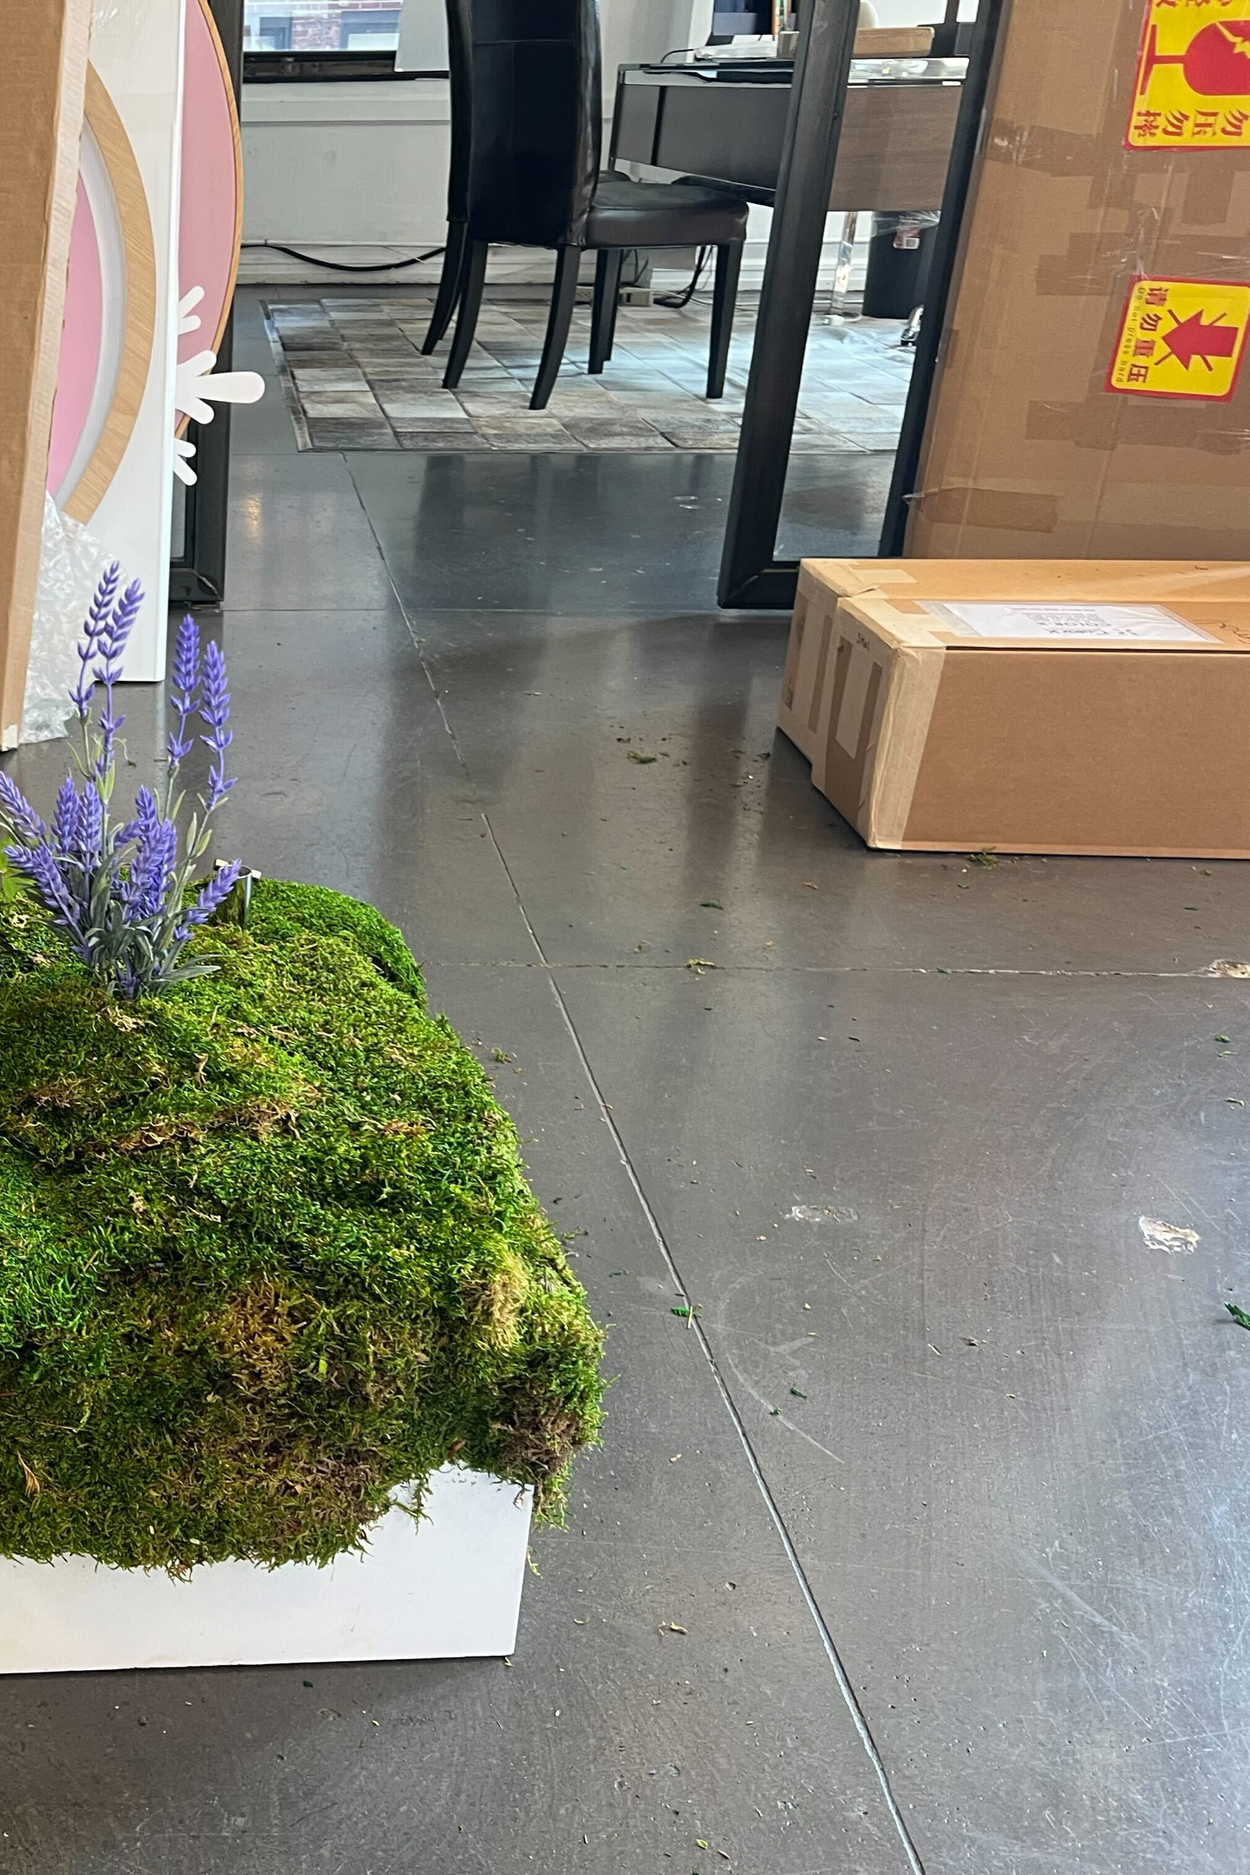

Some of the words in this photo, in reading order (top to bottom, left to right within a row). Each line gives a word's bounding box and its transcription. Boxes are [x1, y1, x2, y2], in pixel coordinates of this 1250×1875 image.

[1135, 286, 1146, 301] Do
[1131, 305, 1140, 322] not
[1126, 286, 1170, 384] 请勿重压
[1116, 359, 1129, 383] hard
